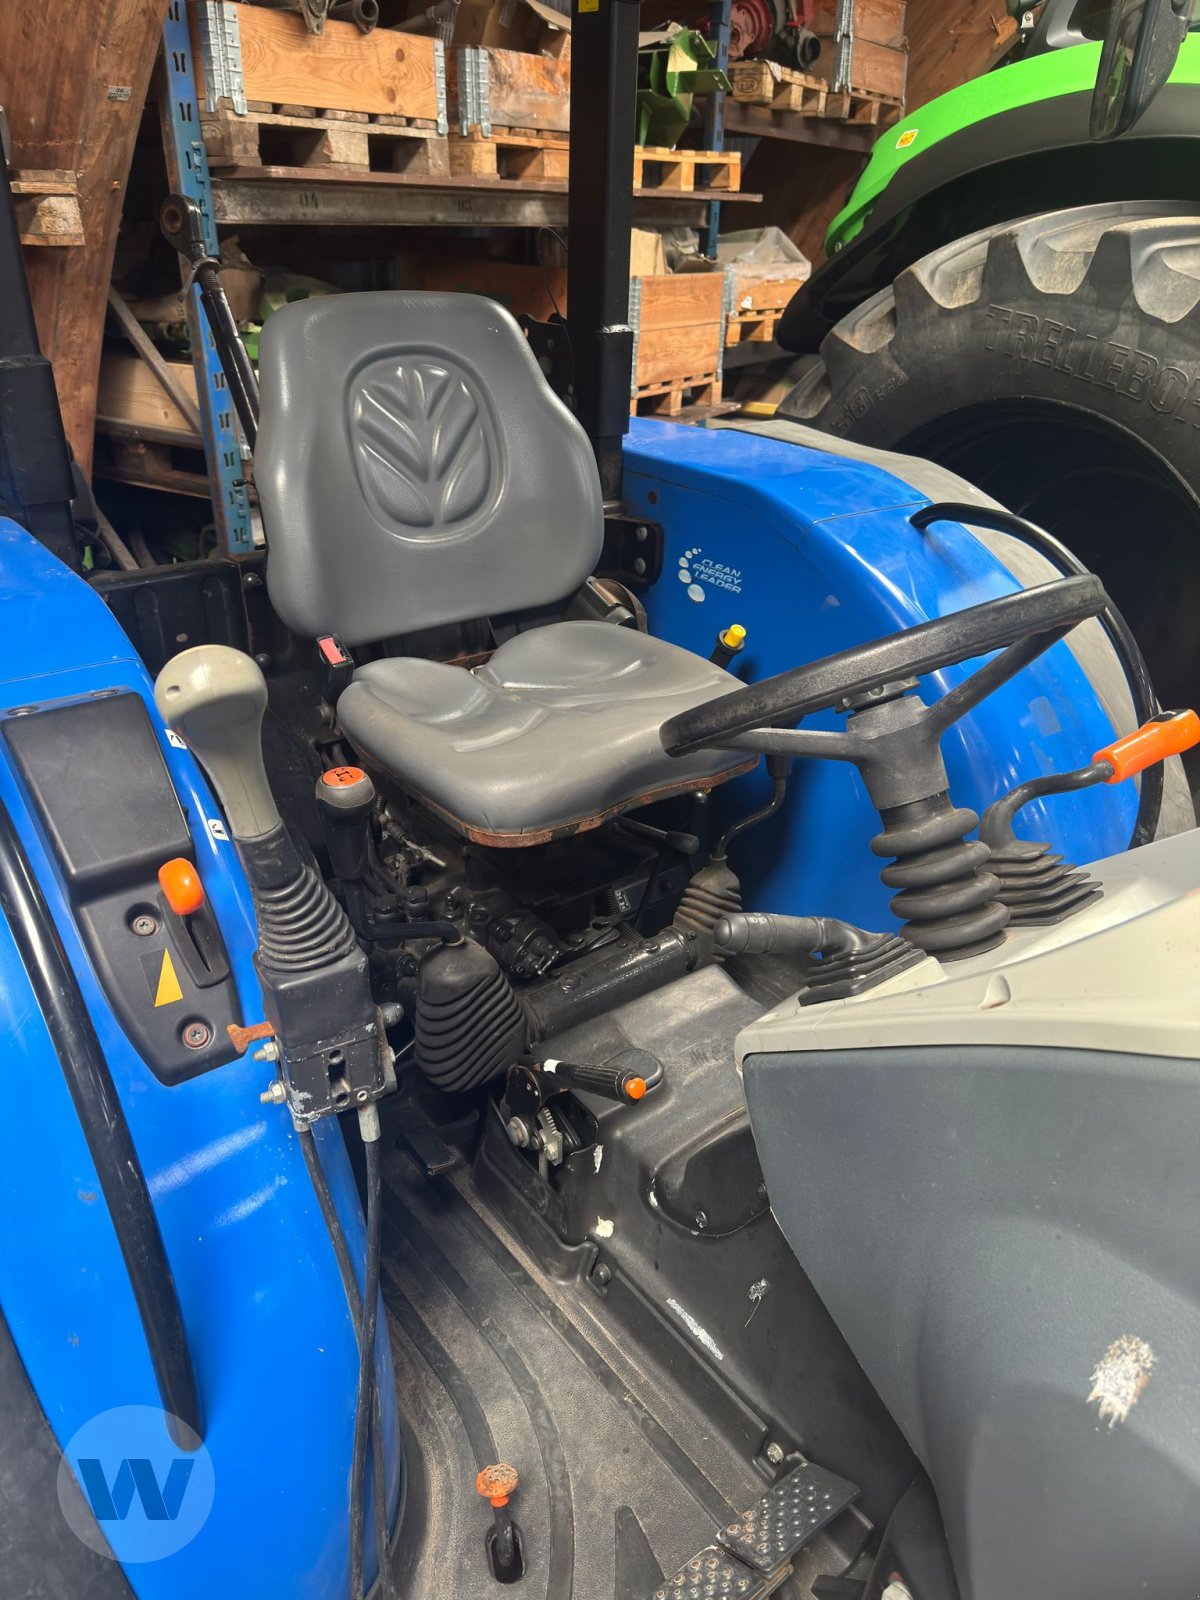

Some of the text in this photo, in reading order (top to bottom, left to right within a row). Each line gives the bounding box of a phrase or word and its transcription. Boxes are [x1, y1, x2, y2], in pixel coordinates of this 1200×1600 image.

[693, 563, 742, 585] ENERGY
[702, 559, 741, 577] CLEAN
[695, 571, 742, 594] LEADER
